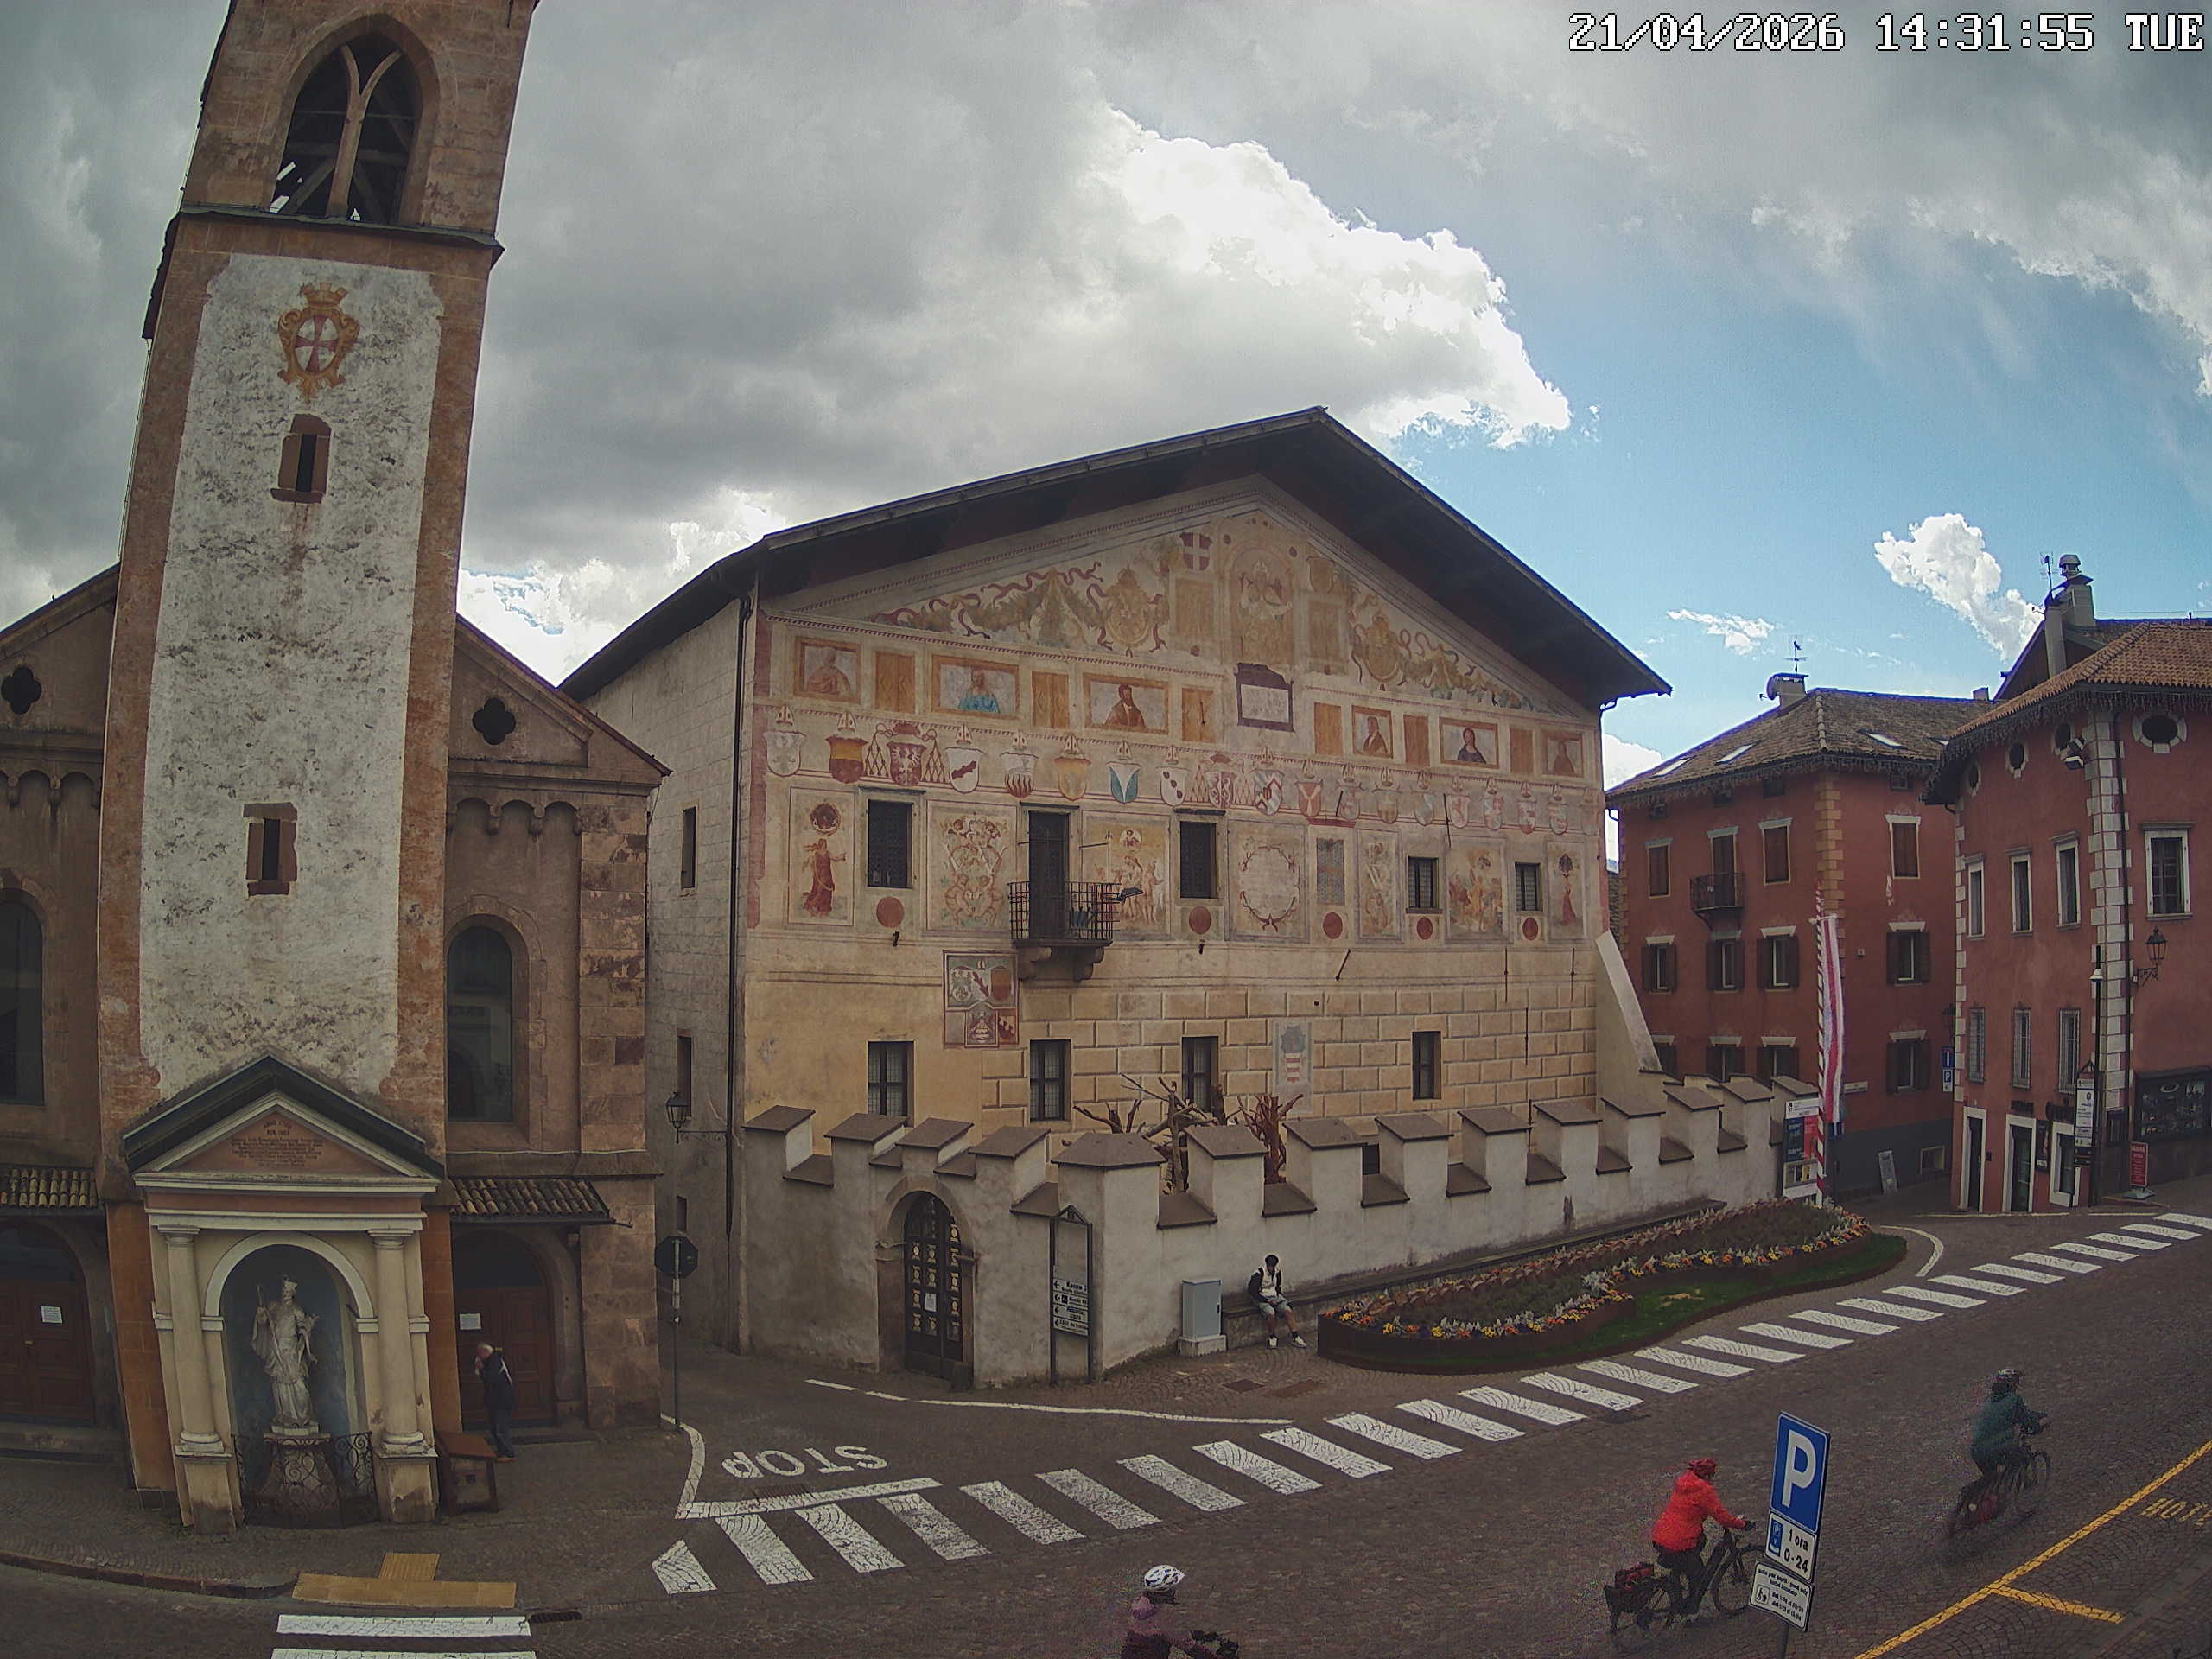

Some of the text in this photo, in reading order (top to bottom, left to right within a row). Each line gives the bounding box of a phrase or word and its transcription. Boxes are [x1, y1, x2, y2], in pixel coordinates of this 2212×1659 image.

[721, 1446, 887, 1479] STOP
[1781, 1429, 1817, 1508] P
[1789, 1529, 1808, 1552] 1 ora
